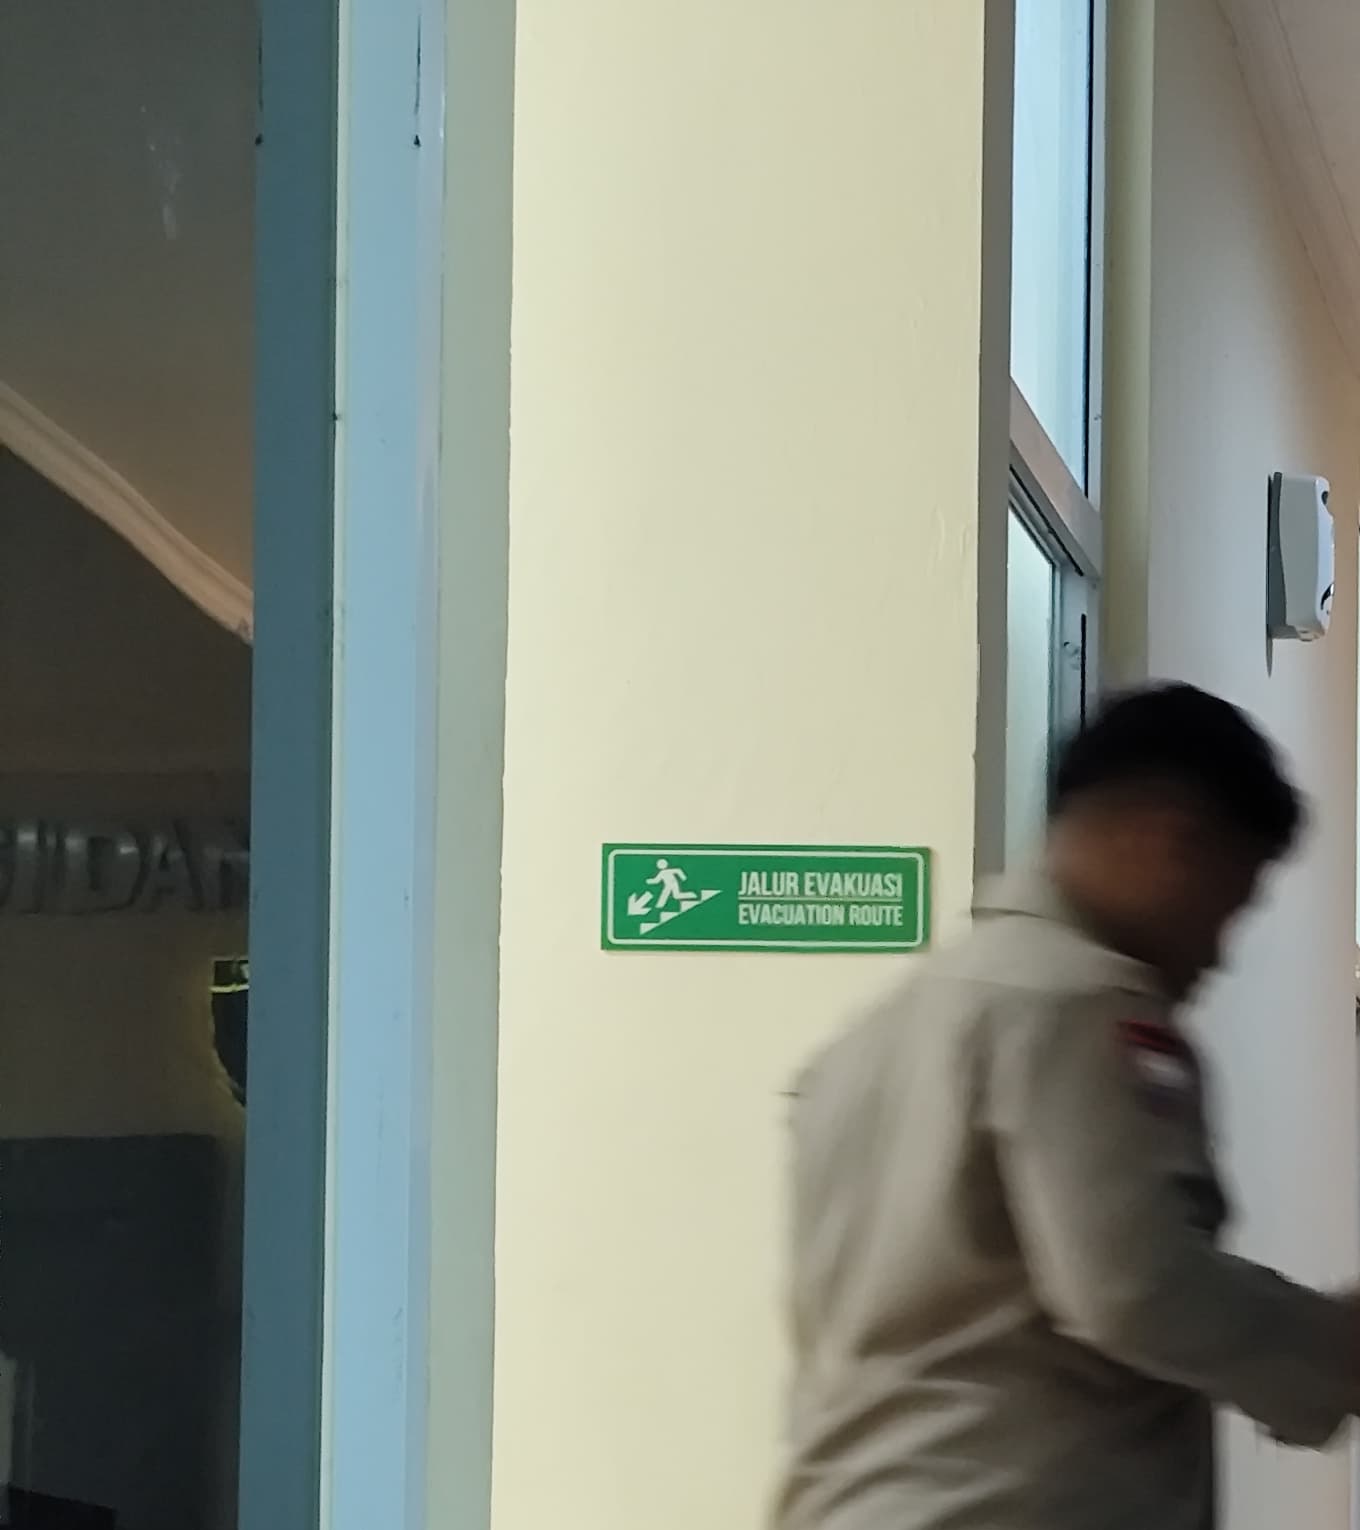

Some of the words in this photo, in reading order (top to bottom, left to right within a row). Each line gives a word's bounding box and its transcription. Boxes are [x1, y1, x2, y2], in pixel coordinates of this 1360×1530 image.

[737, 871, 799, 897] JALUR
[804, 872, 903, 899] EVAKUASI
[738, 903, 845, 926] EVACUATION
[849, 904, 903, 926] ROUTE
